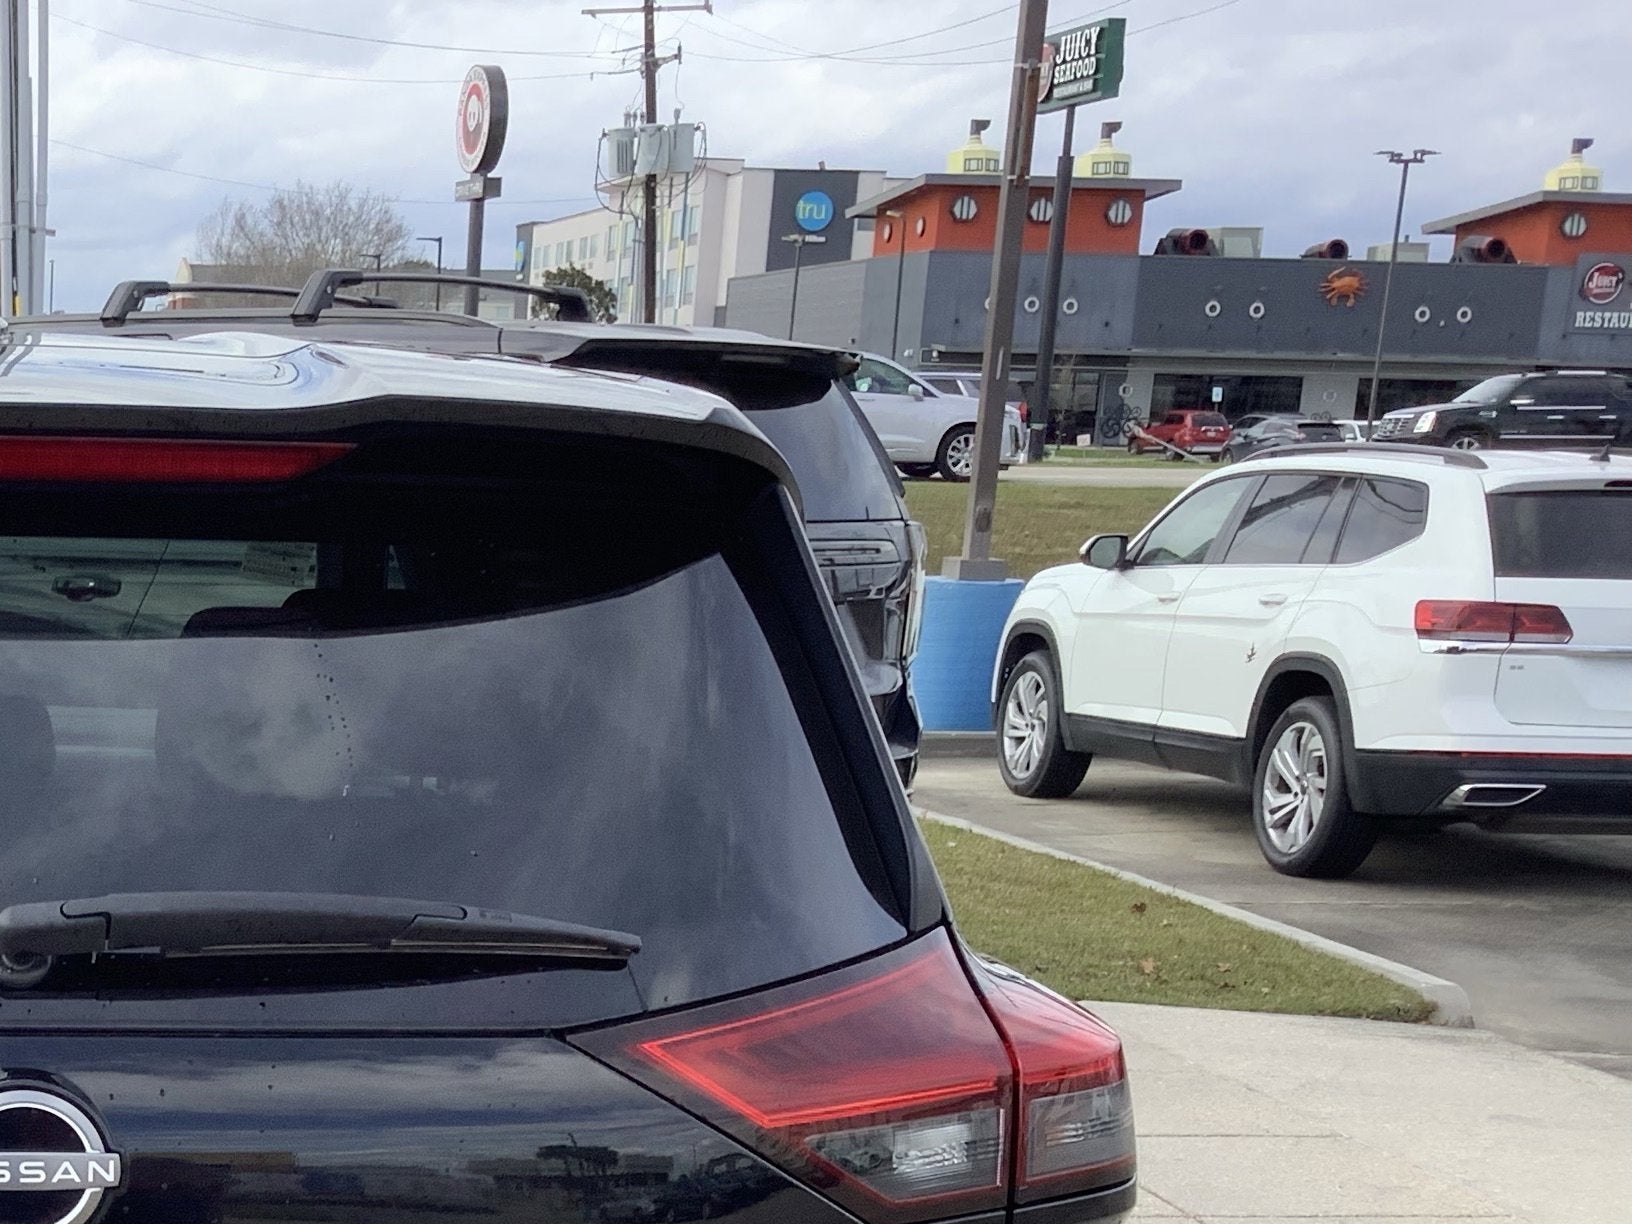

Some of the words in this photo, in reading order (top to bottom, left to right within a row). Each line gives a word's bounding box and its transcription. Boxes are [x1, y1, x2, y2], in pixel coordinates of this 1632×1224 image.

[1055, 26, 1101, 64] JUICY
[1053, 57, 1097, 85] SEAFOOD
[797, 200, 826, 219] tru
[1574, 311, 1632, 329] RESTAU
